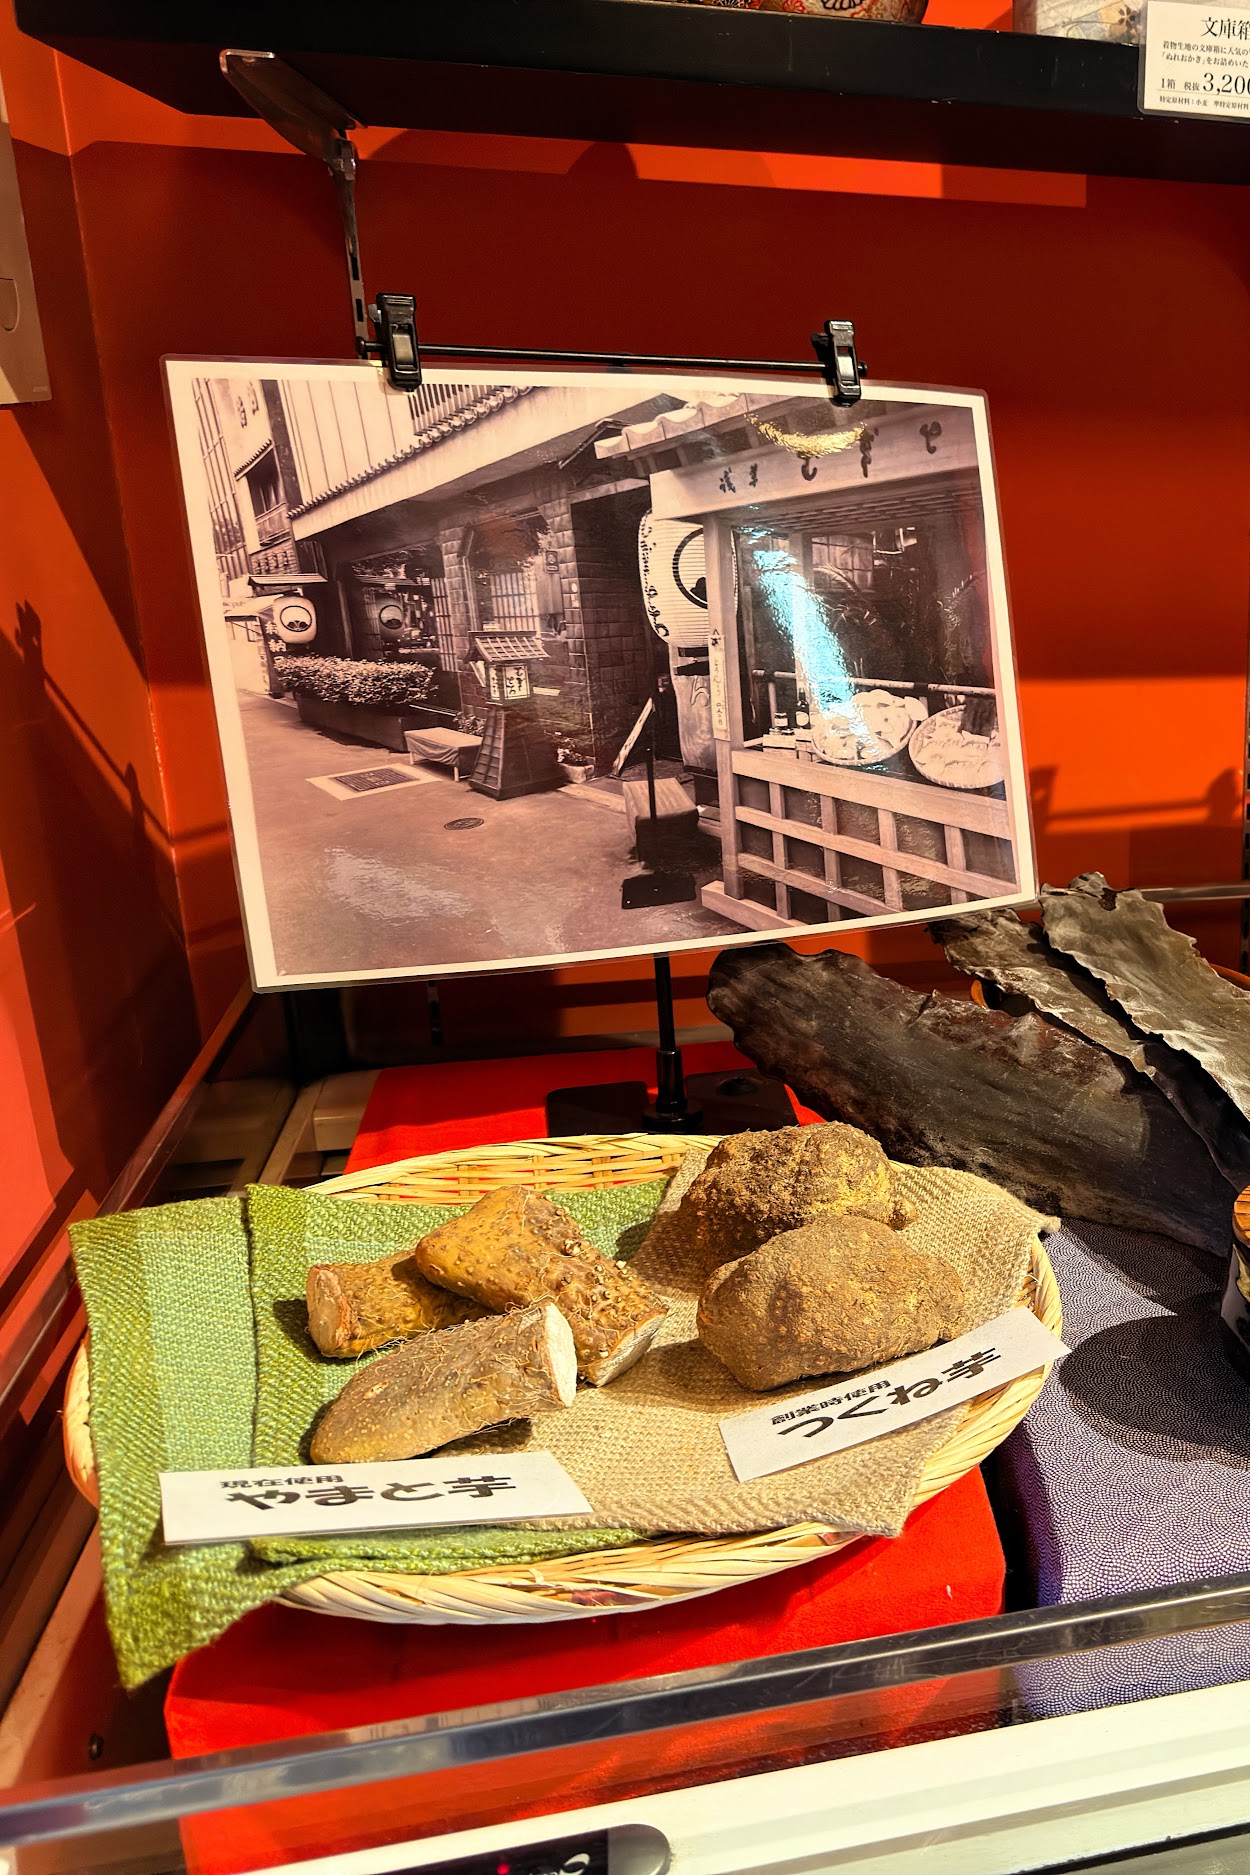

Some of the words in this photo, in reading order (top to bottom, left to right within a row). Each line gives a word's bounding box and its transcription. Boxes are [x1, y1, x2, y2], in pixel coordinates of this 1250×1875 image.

[1161, 78, 1176, 90] 1箱
[777, 1347, 1002, 1438] つくね芋
[220, 1475, 344, 1490] 現在使用
[225, 1475, 517, 1511] やまと芋
